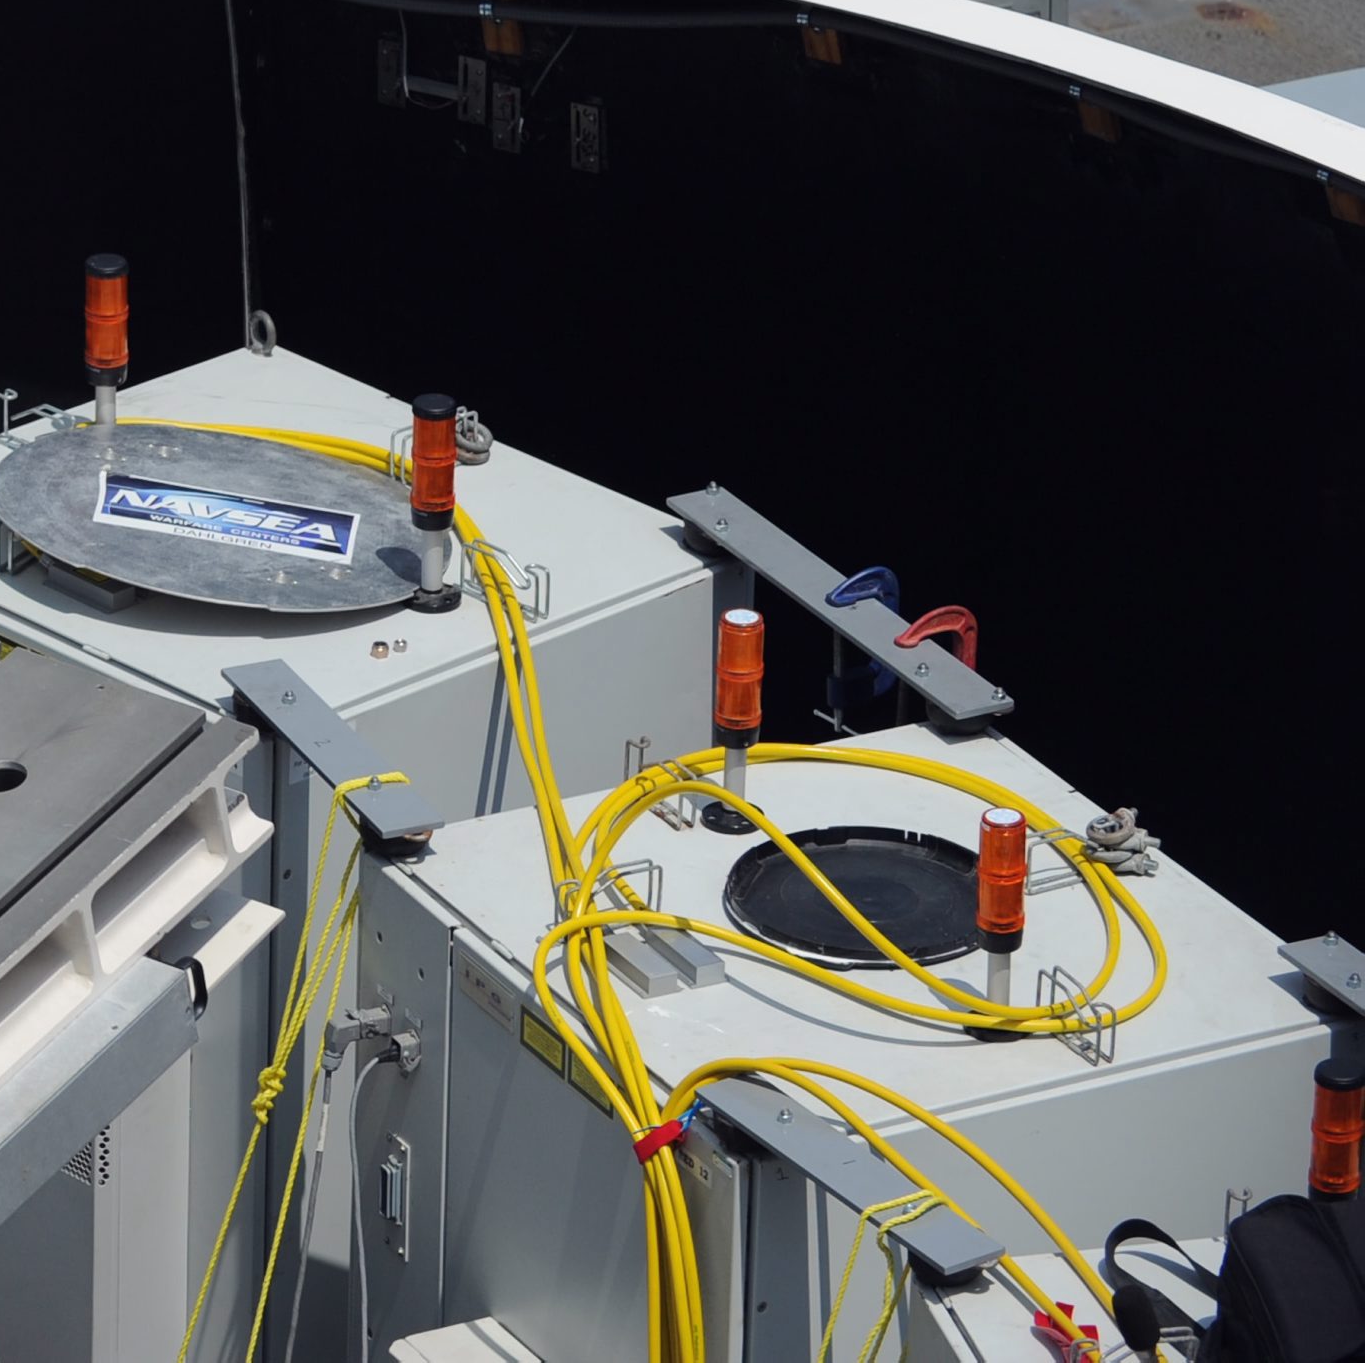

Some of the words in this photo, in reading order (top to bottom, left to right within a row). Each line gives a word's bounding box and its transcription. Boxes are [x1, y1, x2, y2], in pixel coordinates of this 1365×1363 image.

[110, 489, 337, 542] NAVSEA
[149, 513, 224, 533] WARFARE
[230, 528, 301, 547] CENTERS
[173, 527, 273, 550] DAHLGREN
